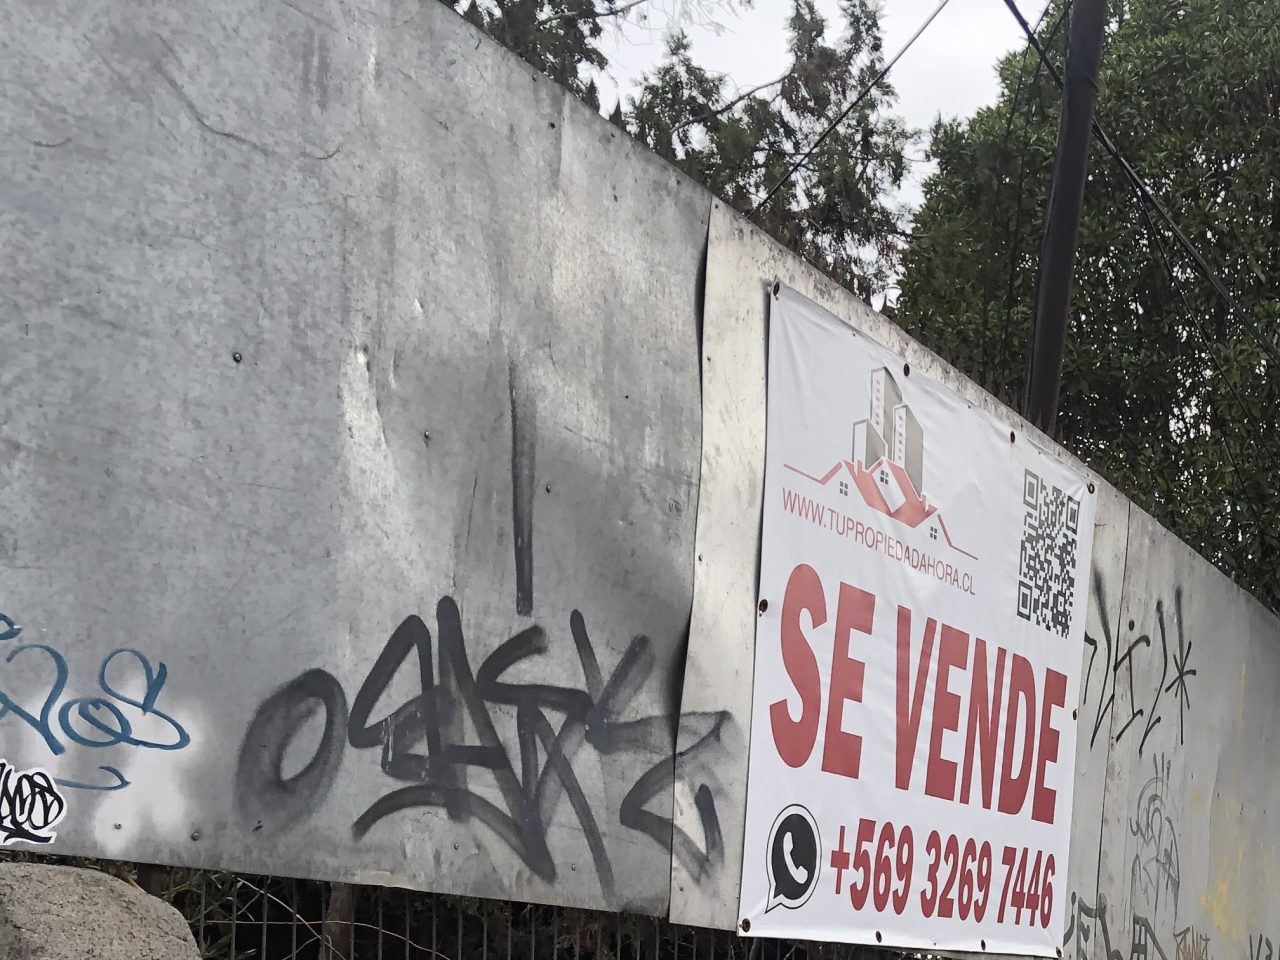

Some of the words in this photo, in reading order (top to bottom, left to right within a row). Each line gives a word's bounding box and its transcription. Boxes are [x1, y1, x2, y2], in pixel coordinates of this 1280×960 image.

[782, 487, 976, 596] WWW.TUPROPIEDADAHORA.CL
[769, 562, 876, 779] SE
[895, 604, 1068, 825] VENDE
[830, 817, 914, 916] +569
[920, 830, 993, 926] 3269
[996, 845, 1057, 930] 7446
